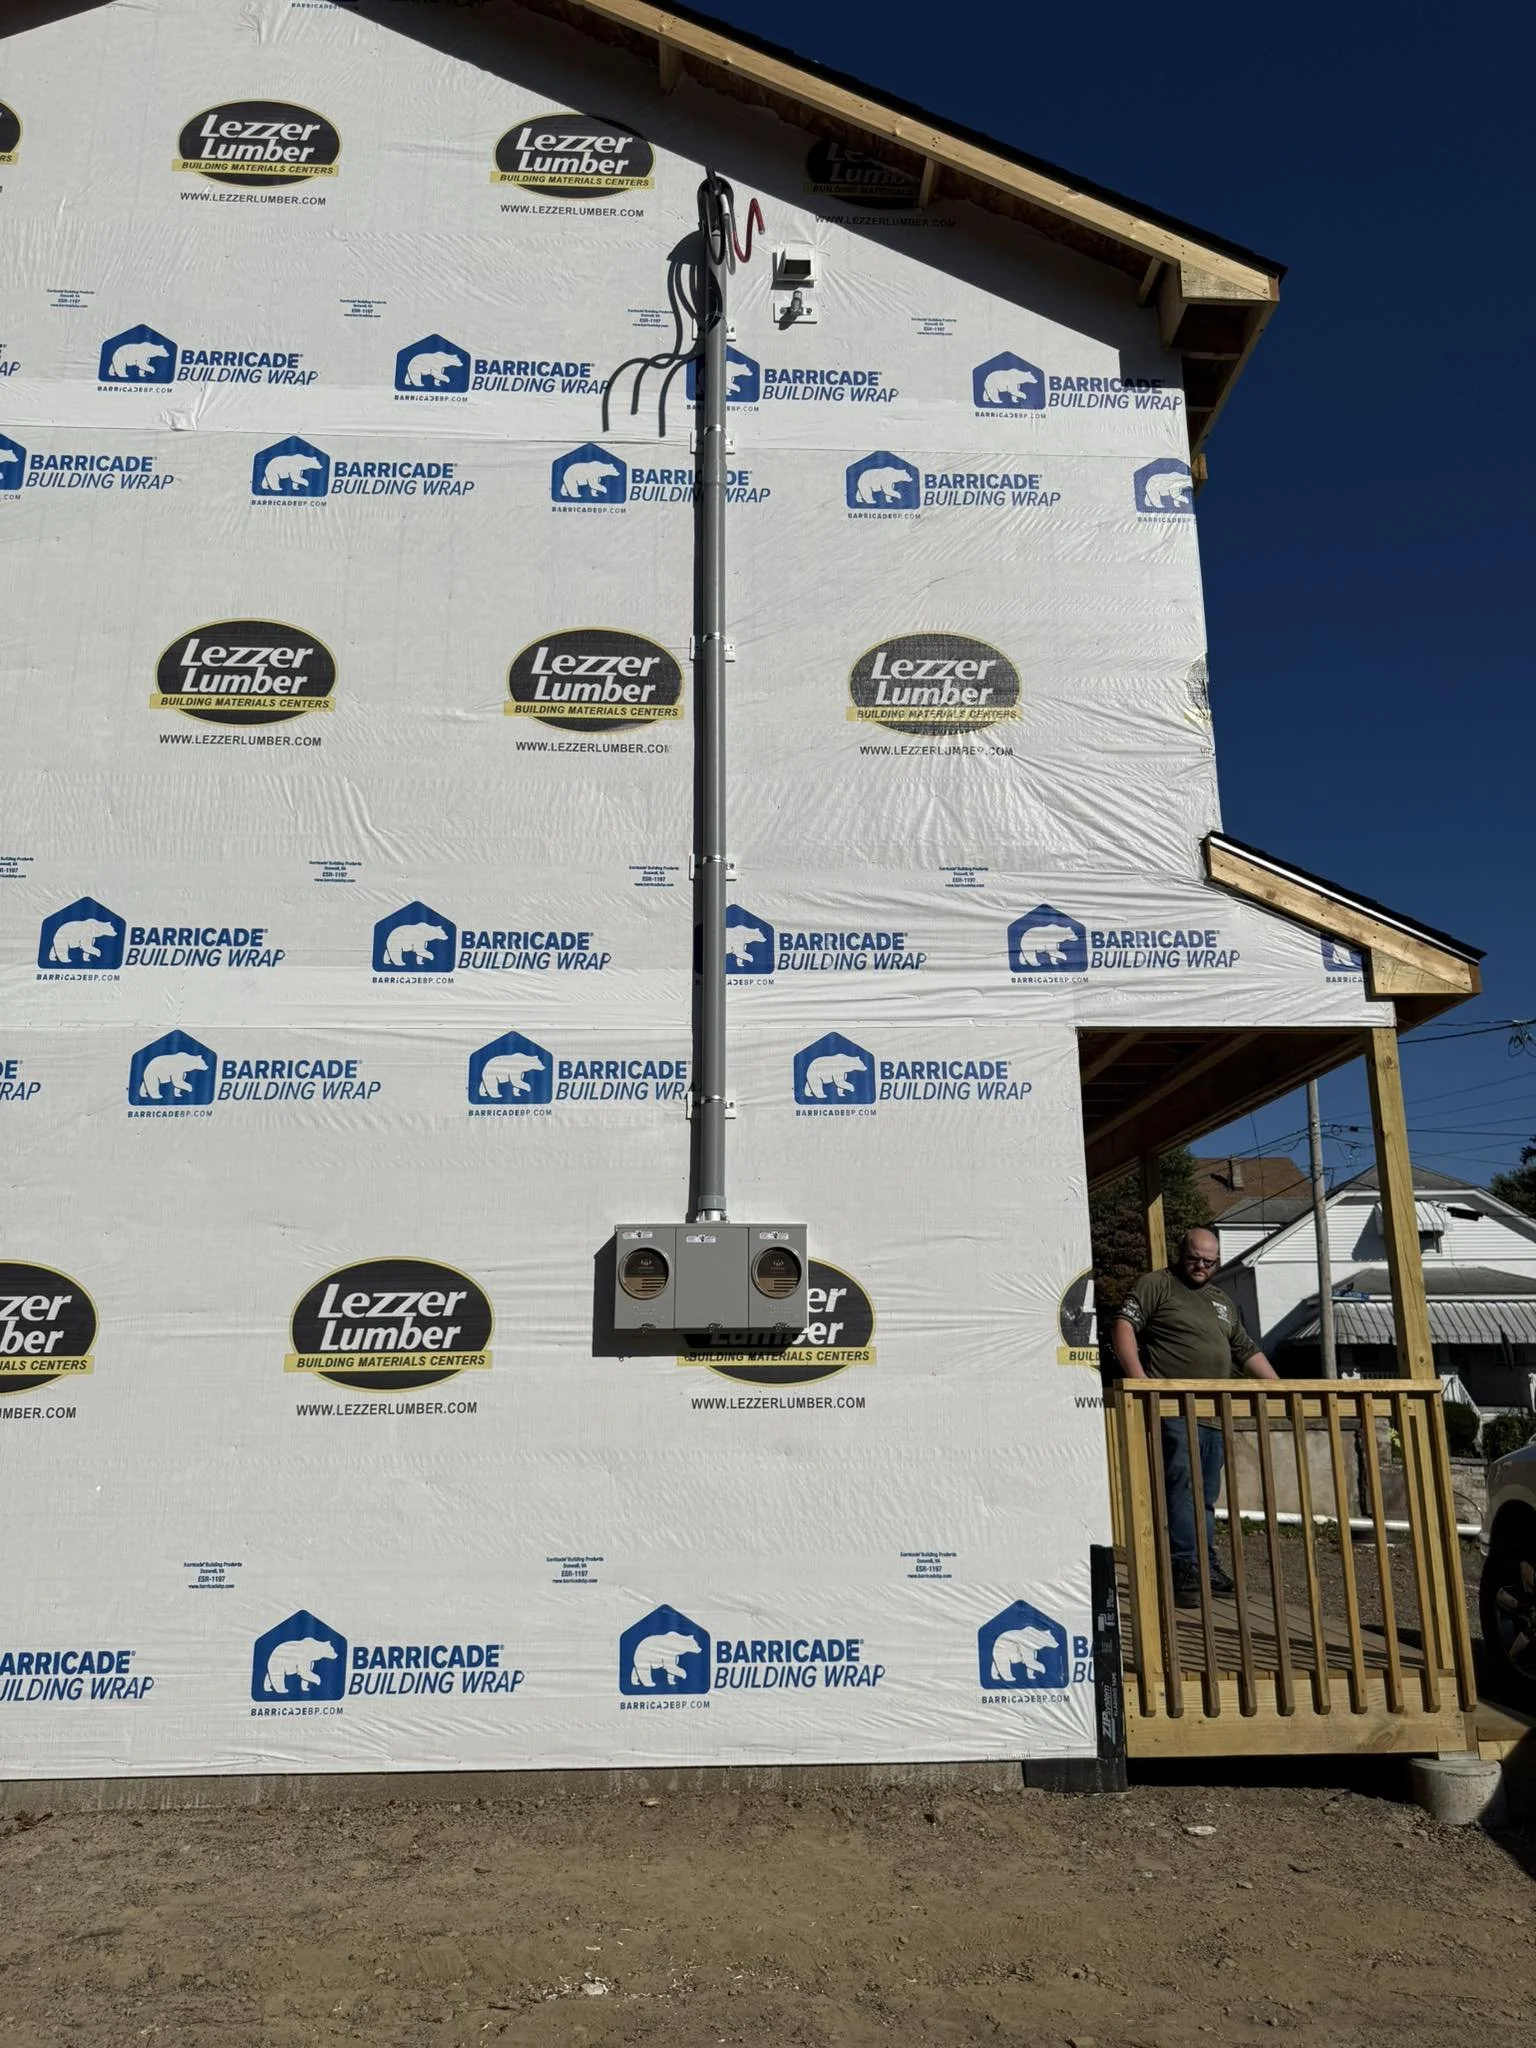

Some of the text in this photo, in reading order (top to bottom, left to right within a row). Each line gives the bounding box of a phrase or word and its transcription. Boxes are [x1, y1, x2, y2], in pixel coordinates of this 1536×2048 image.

[200, 115, 320, 141] Lezzer
[515, 128, 633, 153] Lezzer
[201, 138, 314, 162] Lumber
[182, 161, 334, 175] BUILDING MATERIALS CENTERS
[518, 151, 629, 174] Lumber
[500, 174, 649, 187] BUILDING MATERIALS CENTERS
[180, 192, 326, 206] WWW.LEZZERLUMBER.COM
[500, 204, 644, 217] WWW.LEZZERLUMBER.COM
[177, 367, 318, 386] BUILDING WRAP
[472, 376, 555, 392] BUILDING
[763, 385, 899, 403] BUILDING WRAP
[1049, 392, 1182, 411] BUILDING WRAP
[26, 472, 174, 490] BUILDING WRAP
[331, 479, 475, 496] BUILDING WRAP
[630, 485, 701, 502] BUILDIN
[923, 491, 1061, 506] BUILDING WRAP
[180, 638, 314, 668] Lezzer
[531, 647, 660, 677] Lezzer
[871, 652, 996, 680] Lezzer
[181, 666, 308, 694] Lumber
[534, 675, 656, 703] Lumber
[875, 678, 994, 706] Lumber
[160, 697, 329, 708] BUILDING MATERIALS CENTERS
[514, 705, 678, 716] BUILDING MATERIALS CENTERS
[857, 710, 1016, 719] BUILDING MATERIALS CENTERS
[159, 734, 321, 746] WWW.LEZZERLUMBER.COM
[126, 948, 285, 967] BUILDING WRAP
[459, 951, 612, 970] BUILDING WRAP
[777, 953, 927, 970] BUILDING WRAP
[1090, 950, 1240, 969] BUILDING WRAP
[218, 1081, 381, 1100] BUILDING WRAP
[556, 1082, 649, 1100] BUILDING
[879, 1082, 1032, 1100] BUILDING WRAP
[318, 1283, 467, 1318] Lezzer
[320, 1316, 461, 1350] Lumber
[30, 1360, 87, 1370] CENTERS
[297, 1355, 485, 1368] BUILDING MATERIALS CENTERS
[689, 1350, 870, 1362] BUILDING MATERIALS CENTERS
[296, 1402, 477, 1416] WWW.LEZZERLUMBER.COM
[691, 1397, 866, 1410] WWW.LEZZERLUMBER.COM
[0, 1651, 131, 1675] ARRICADE
[349, 1670, 525, 1695] BUILDING WRAP
[714, 1664, 886, 1688] BUILDING WRAP
[91, 1677, 154, 1699] WRAP
